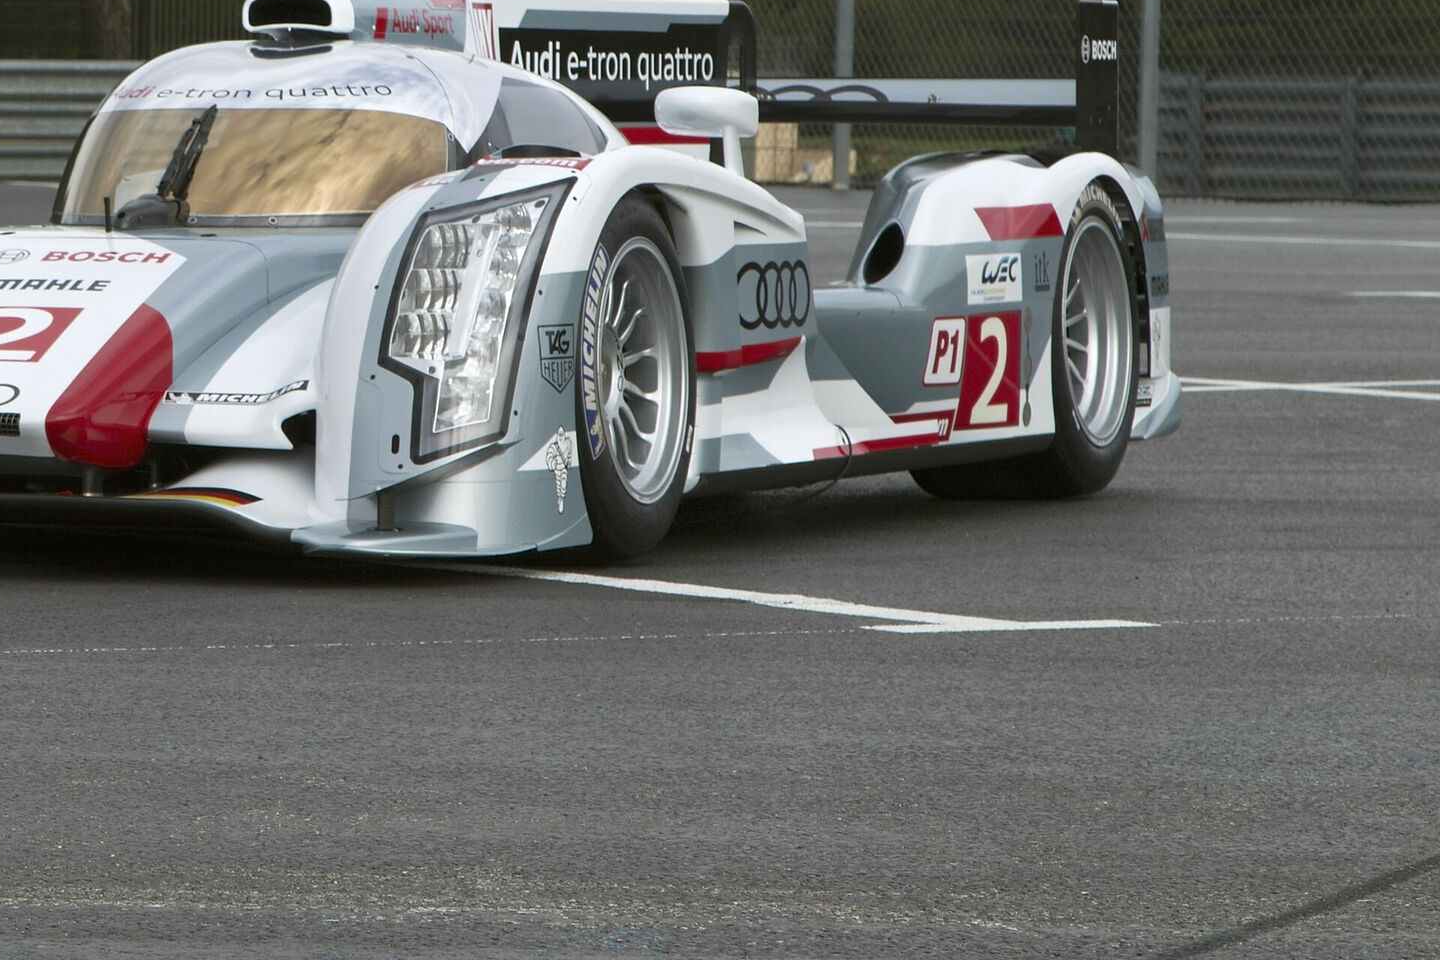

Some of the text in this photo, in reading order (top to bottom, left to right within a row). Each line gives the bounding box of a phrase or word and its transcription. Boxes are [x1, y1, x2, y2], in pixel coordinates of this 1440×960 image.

[392, 7, 420, 33] Audi
[422, 8, 455, 40] Sport
[1092, 40, 1117, 60] BOSCH
[510, 40, 714, 91] Audi e-tron quattro
[157, 88, 251, 99] e-tron
[265, 84, 393, 100] quattro
[41, 251, 171, 264] BOSCH
[981, 256, 1019, 285] WEC
[545, 330, 570, 355] TAG
[582, 247, 609, 411] MICHELIN
[932, 329, 960, 374] P1
[544, 359, 574, 383] HEUER
[969, 316, 1009, 425] 2
[195, 381, 305, 403] MICHELIN
